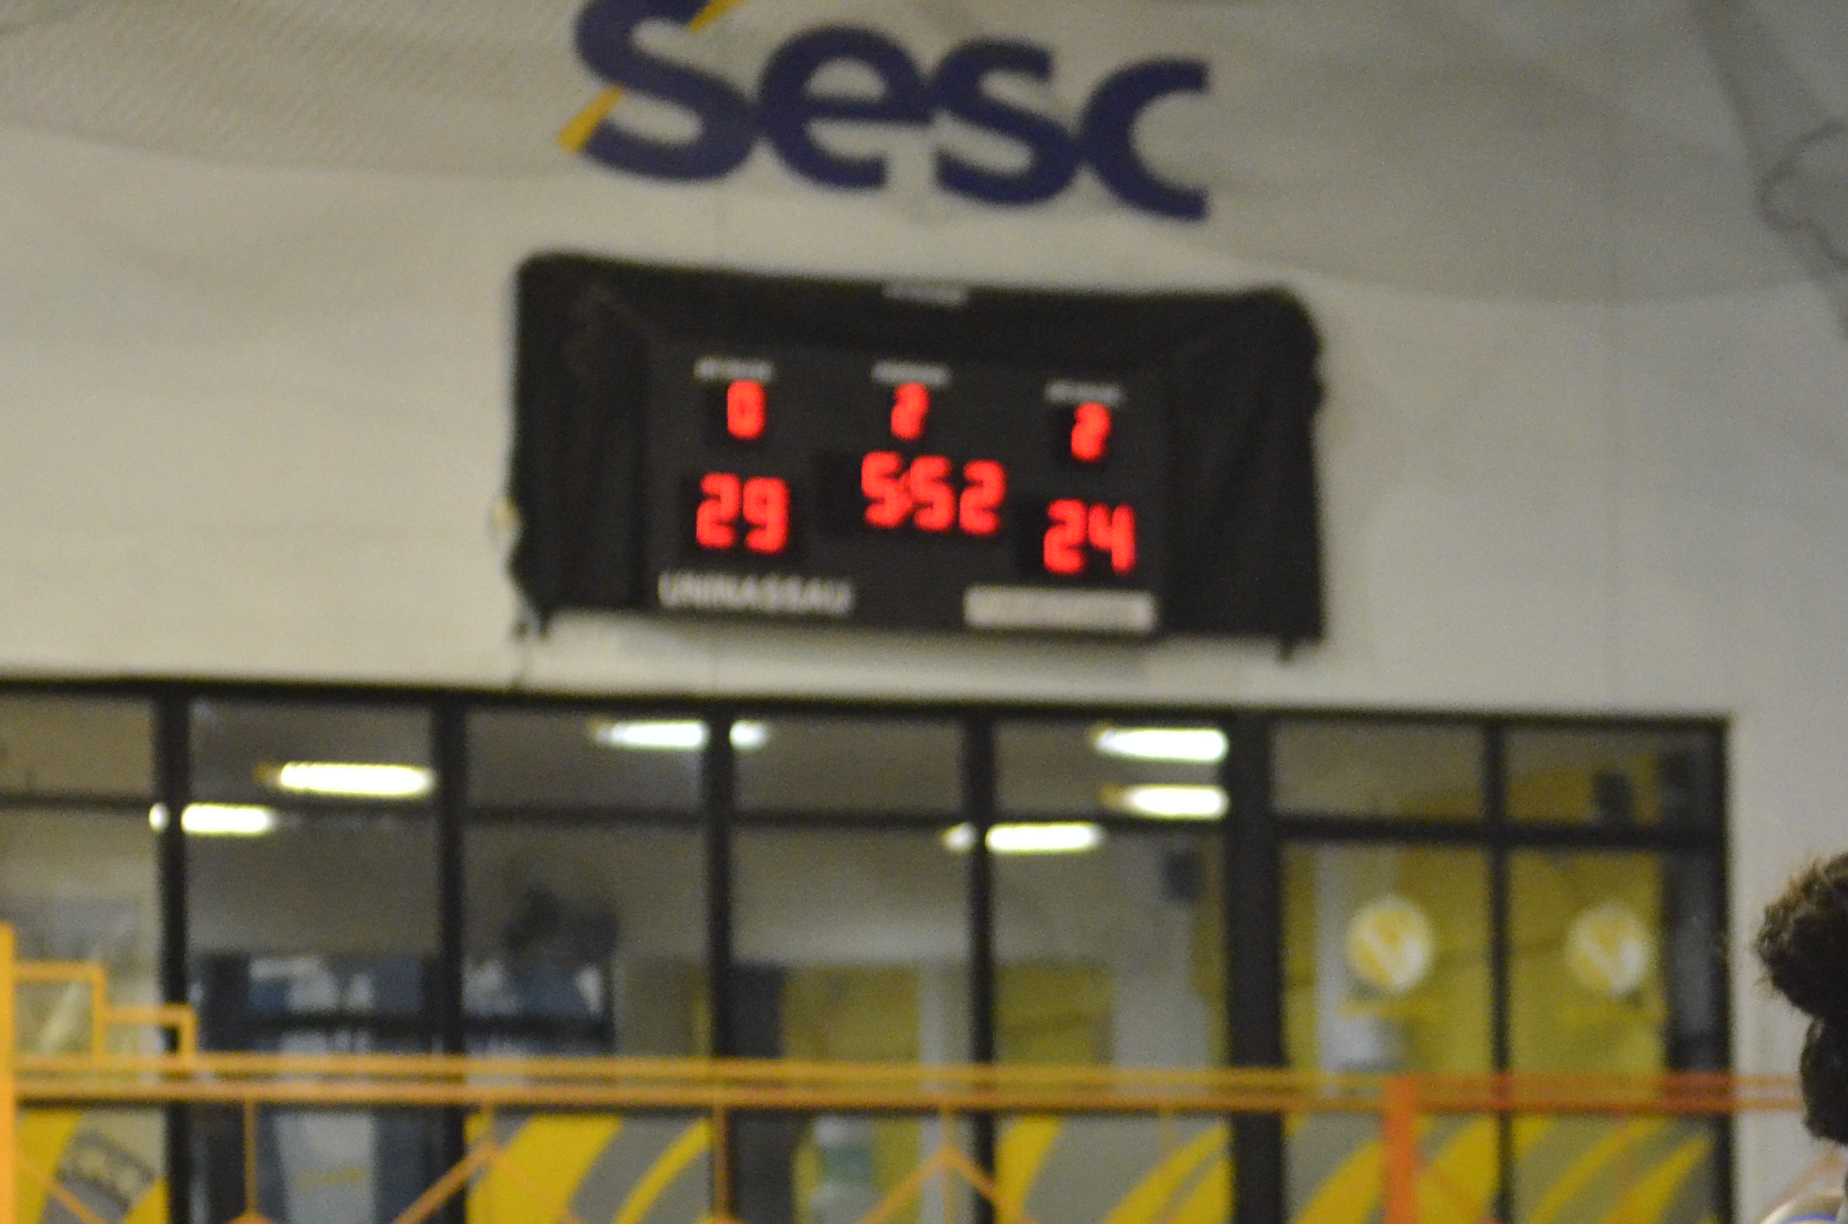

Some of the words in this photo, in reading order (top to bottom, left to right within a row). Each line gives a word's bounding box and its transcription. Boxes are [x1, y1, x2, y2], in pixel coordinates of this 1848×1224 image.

[566, 0, 1211, 222] Sesc
[695, 471, 791, 555] 29
[1042, 497, 1137, 575] 24
